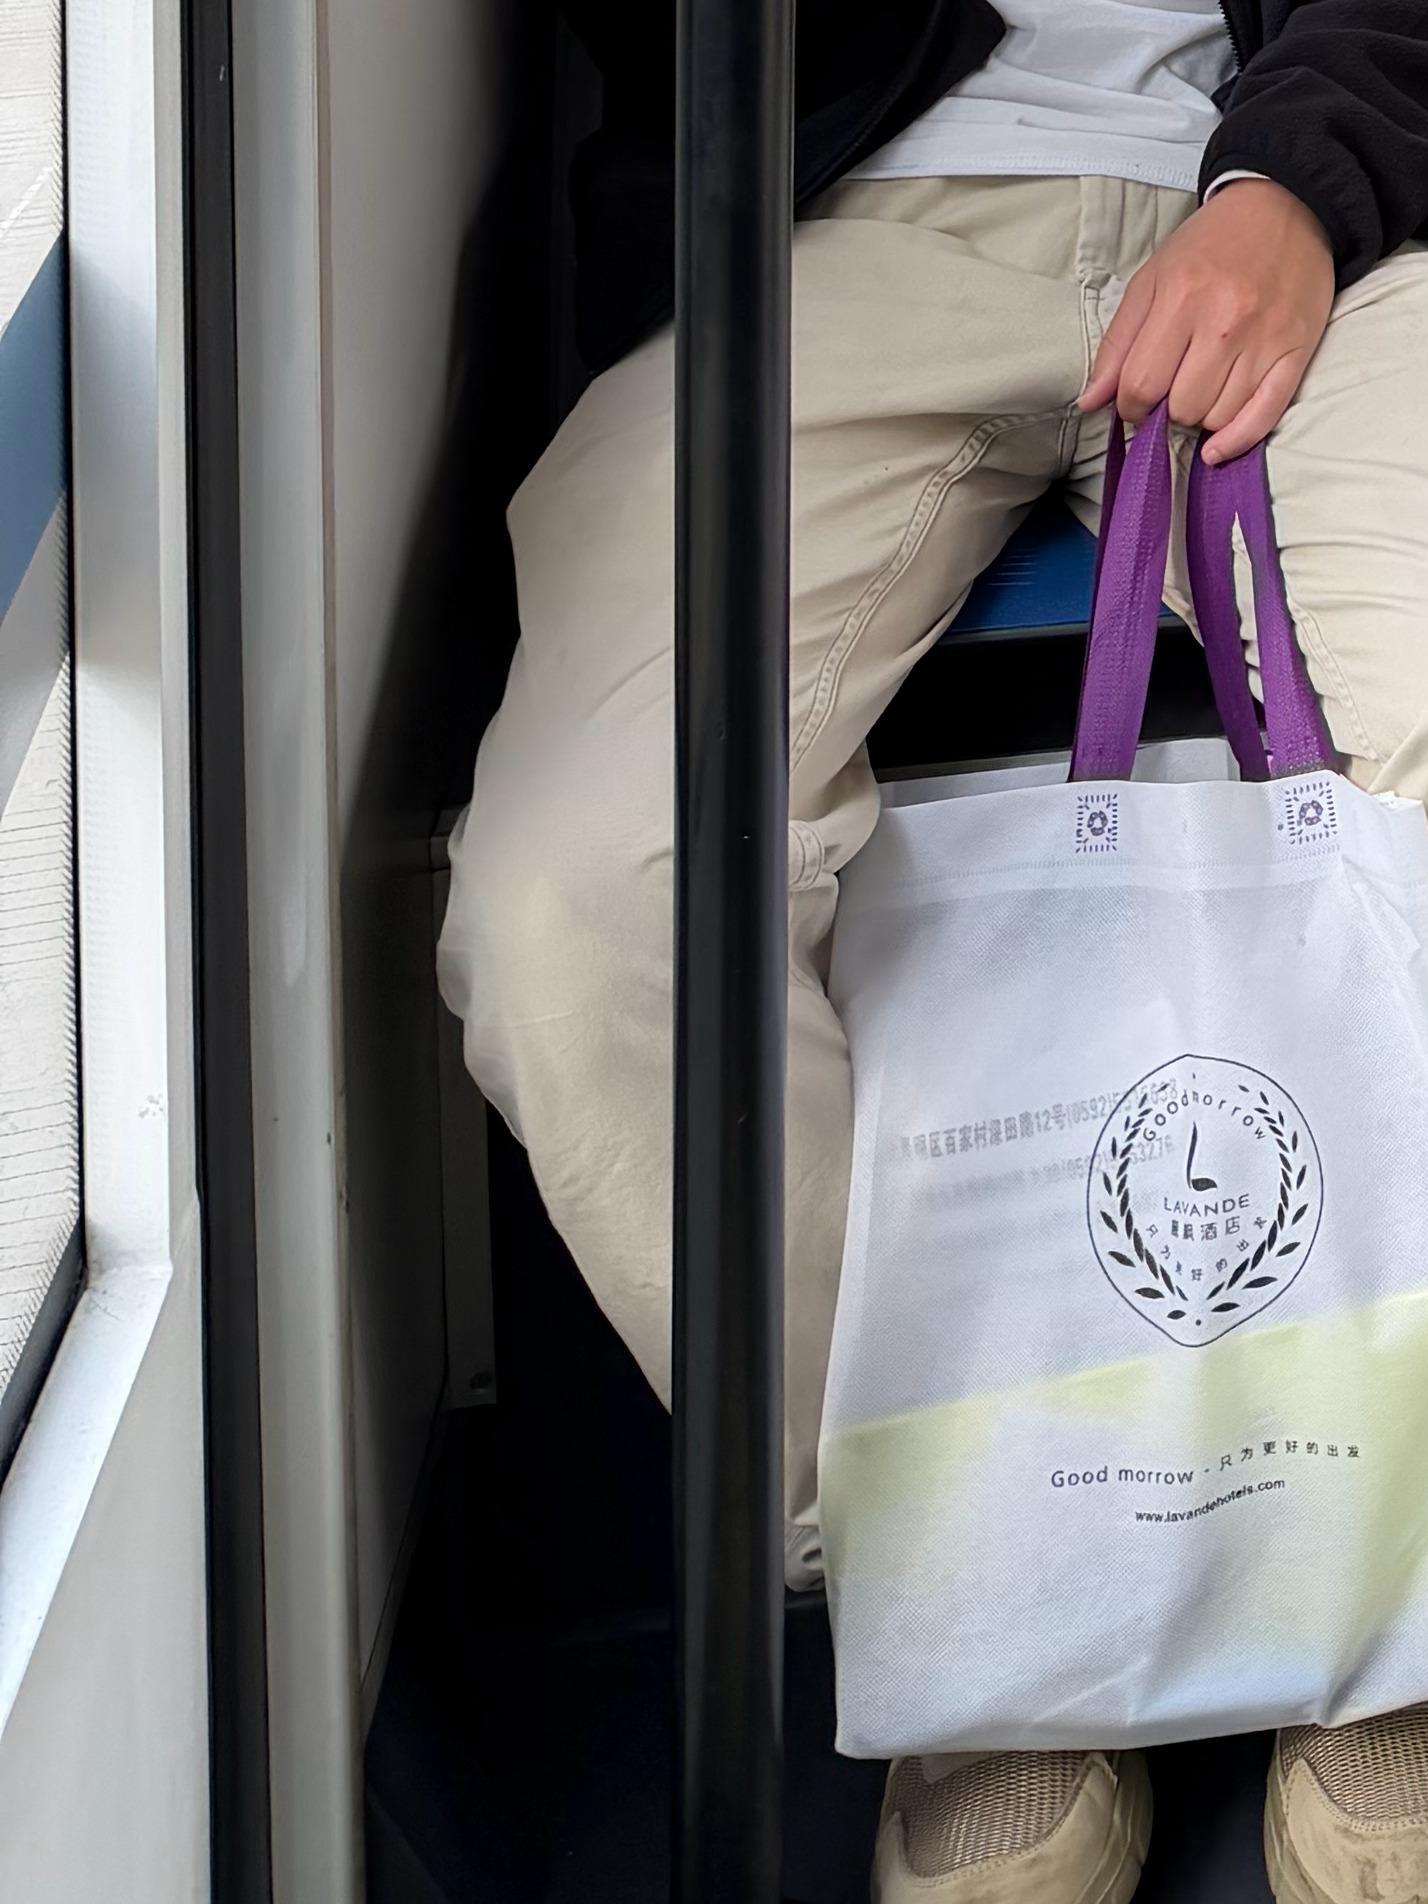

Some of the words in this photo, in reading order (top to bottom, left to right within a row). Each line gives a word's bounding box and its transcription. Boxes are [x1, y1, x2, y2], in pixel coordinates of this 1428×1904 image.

[1163, 1193, 1251, 1218] LAVANDE
[1219, 1439, 1360, 1471] 只为更好的出发
[1051, 1466, 1109, 1488] Good
[1118, 1467, 1194, 1485] morrow
[1135, 1478, 1285, 1523] www.lavandehotels.com
